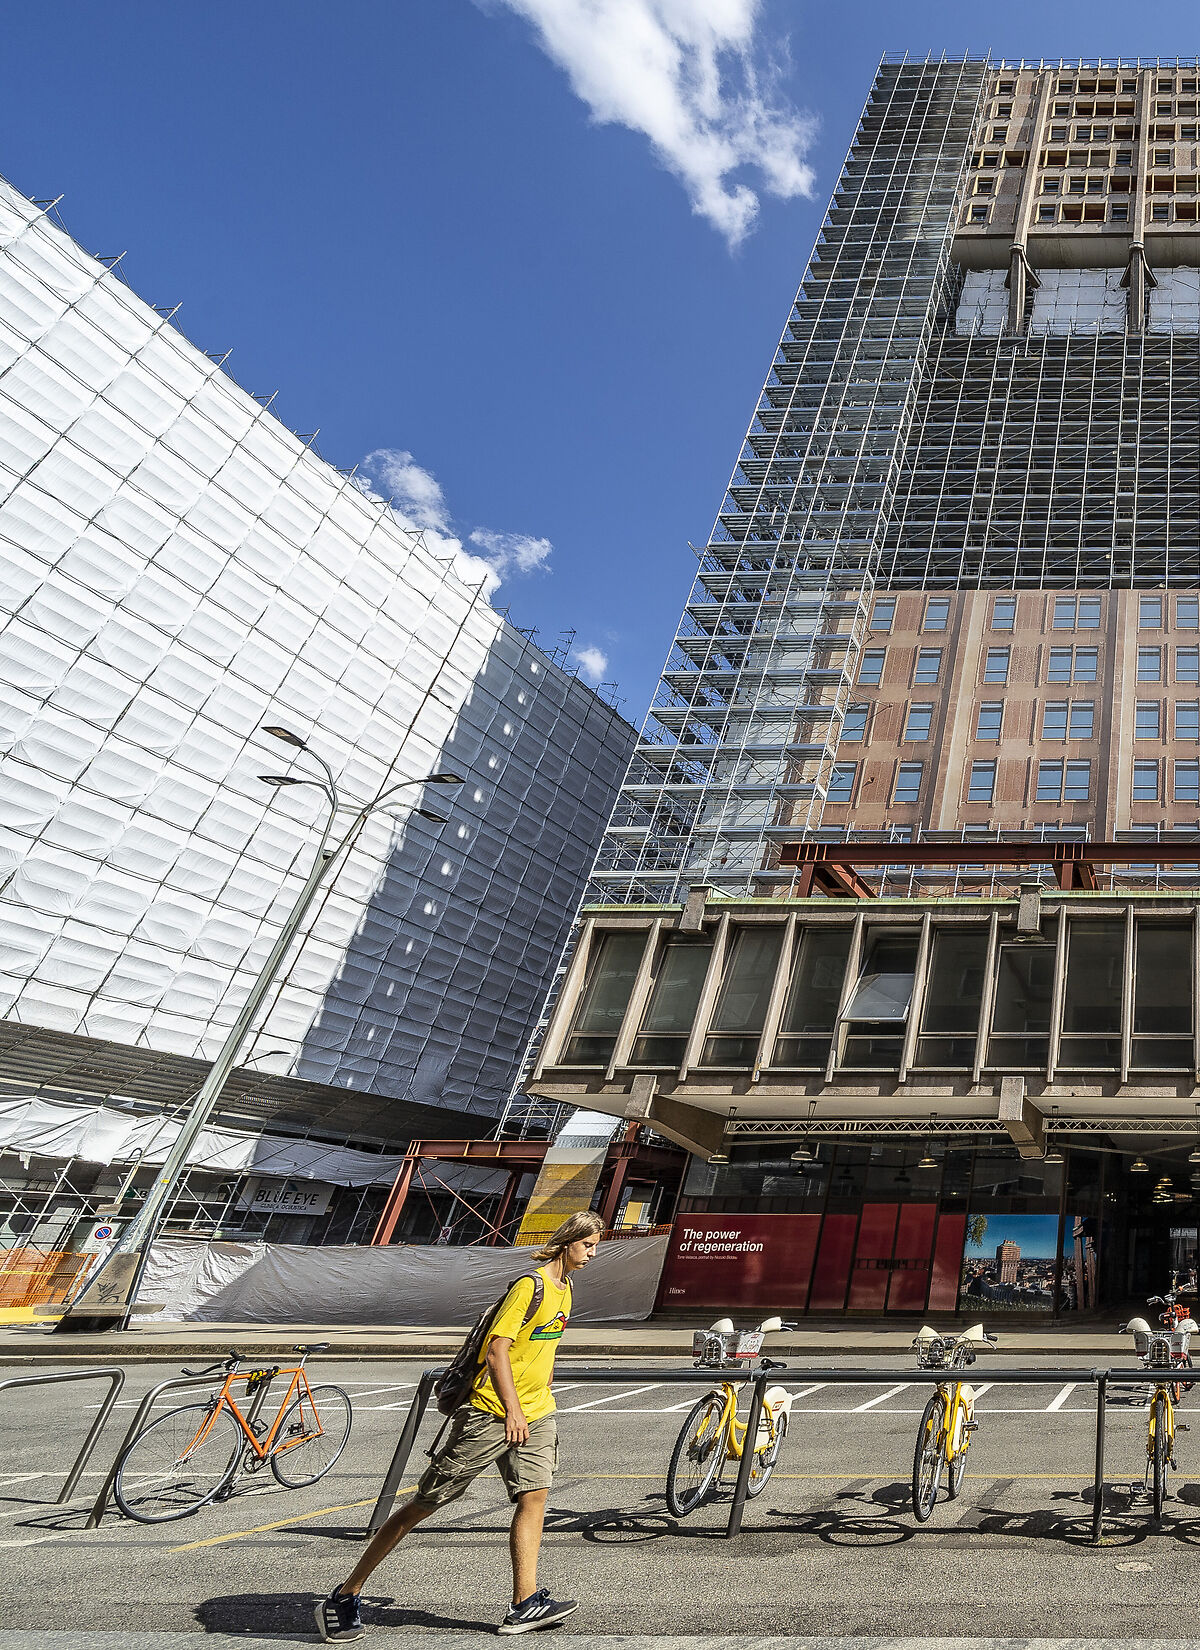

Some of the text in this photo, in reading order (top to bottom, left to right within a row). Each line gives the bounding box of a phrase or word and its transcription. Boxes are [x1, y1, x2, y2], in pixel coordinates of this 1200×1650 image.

[255, 1189, 320, 1206] BLUE EYE
[683, 1228, 741, 1242] The power
[679, 1240, 764, 1254] of regeneration
